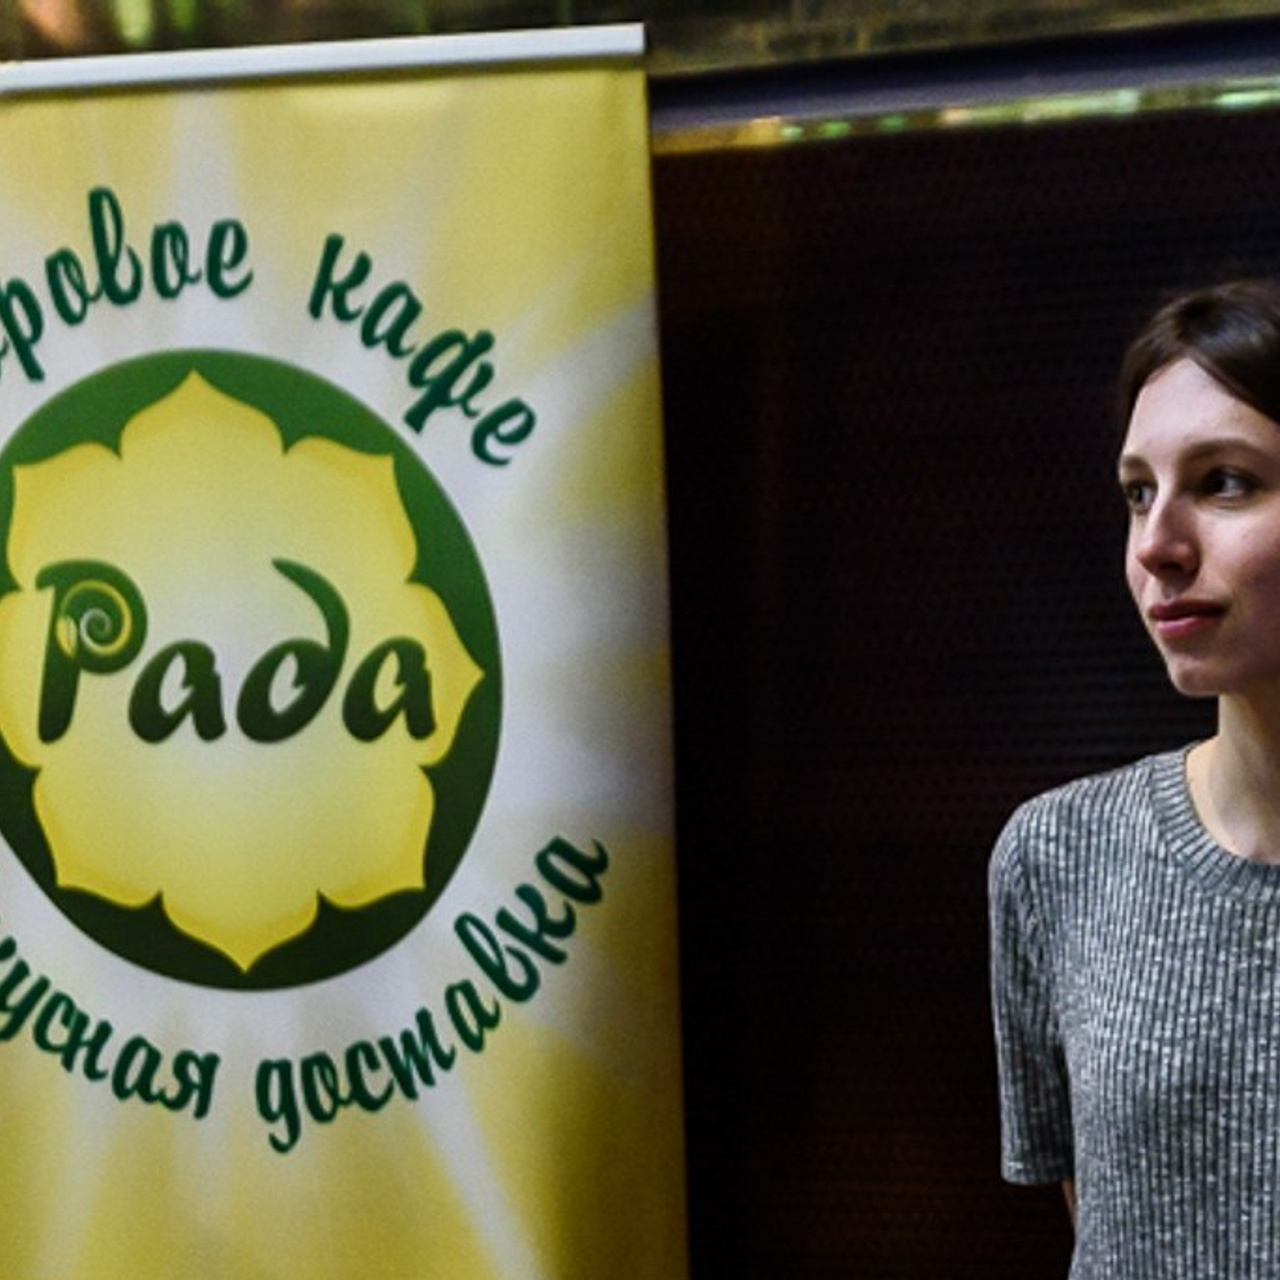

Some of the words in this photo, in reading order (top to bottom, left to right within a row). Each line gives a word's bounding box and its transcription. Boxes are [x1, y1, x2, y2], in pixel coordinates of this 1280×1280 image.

[0, 186, 254, 383] ровое
[308, 232, 537, 467] кафе
[35, 557, 438, 745] Рада
[0, 936, 221, 1121] усная
[256, 835, 610, 1155] доставка
